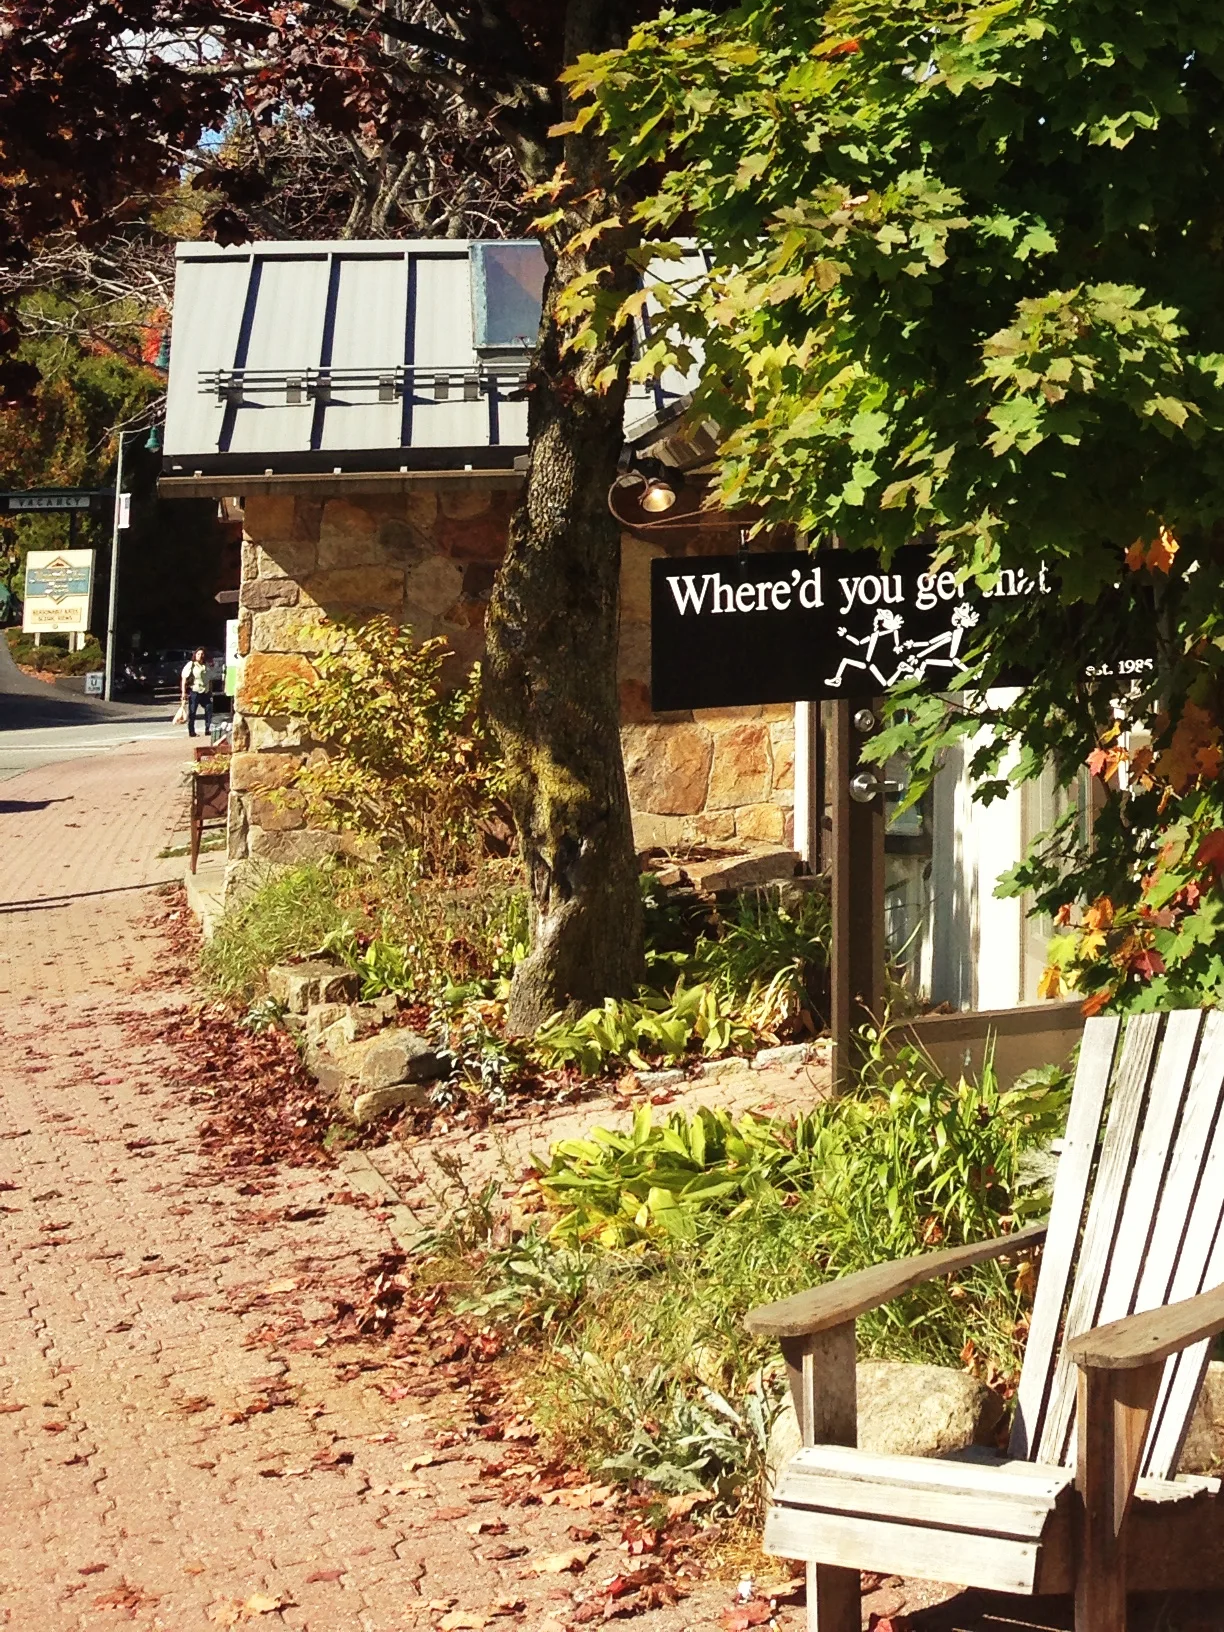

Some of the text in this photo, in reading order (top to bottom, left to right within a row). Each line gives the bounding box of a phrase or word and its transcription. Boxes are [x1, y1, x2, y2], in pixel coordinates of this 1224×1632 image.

[666, 567, 824, 615] Where'd
[838, 574, 905, 615] you
[1118, 658, 1154, 675] 1985
